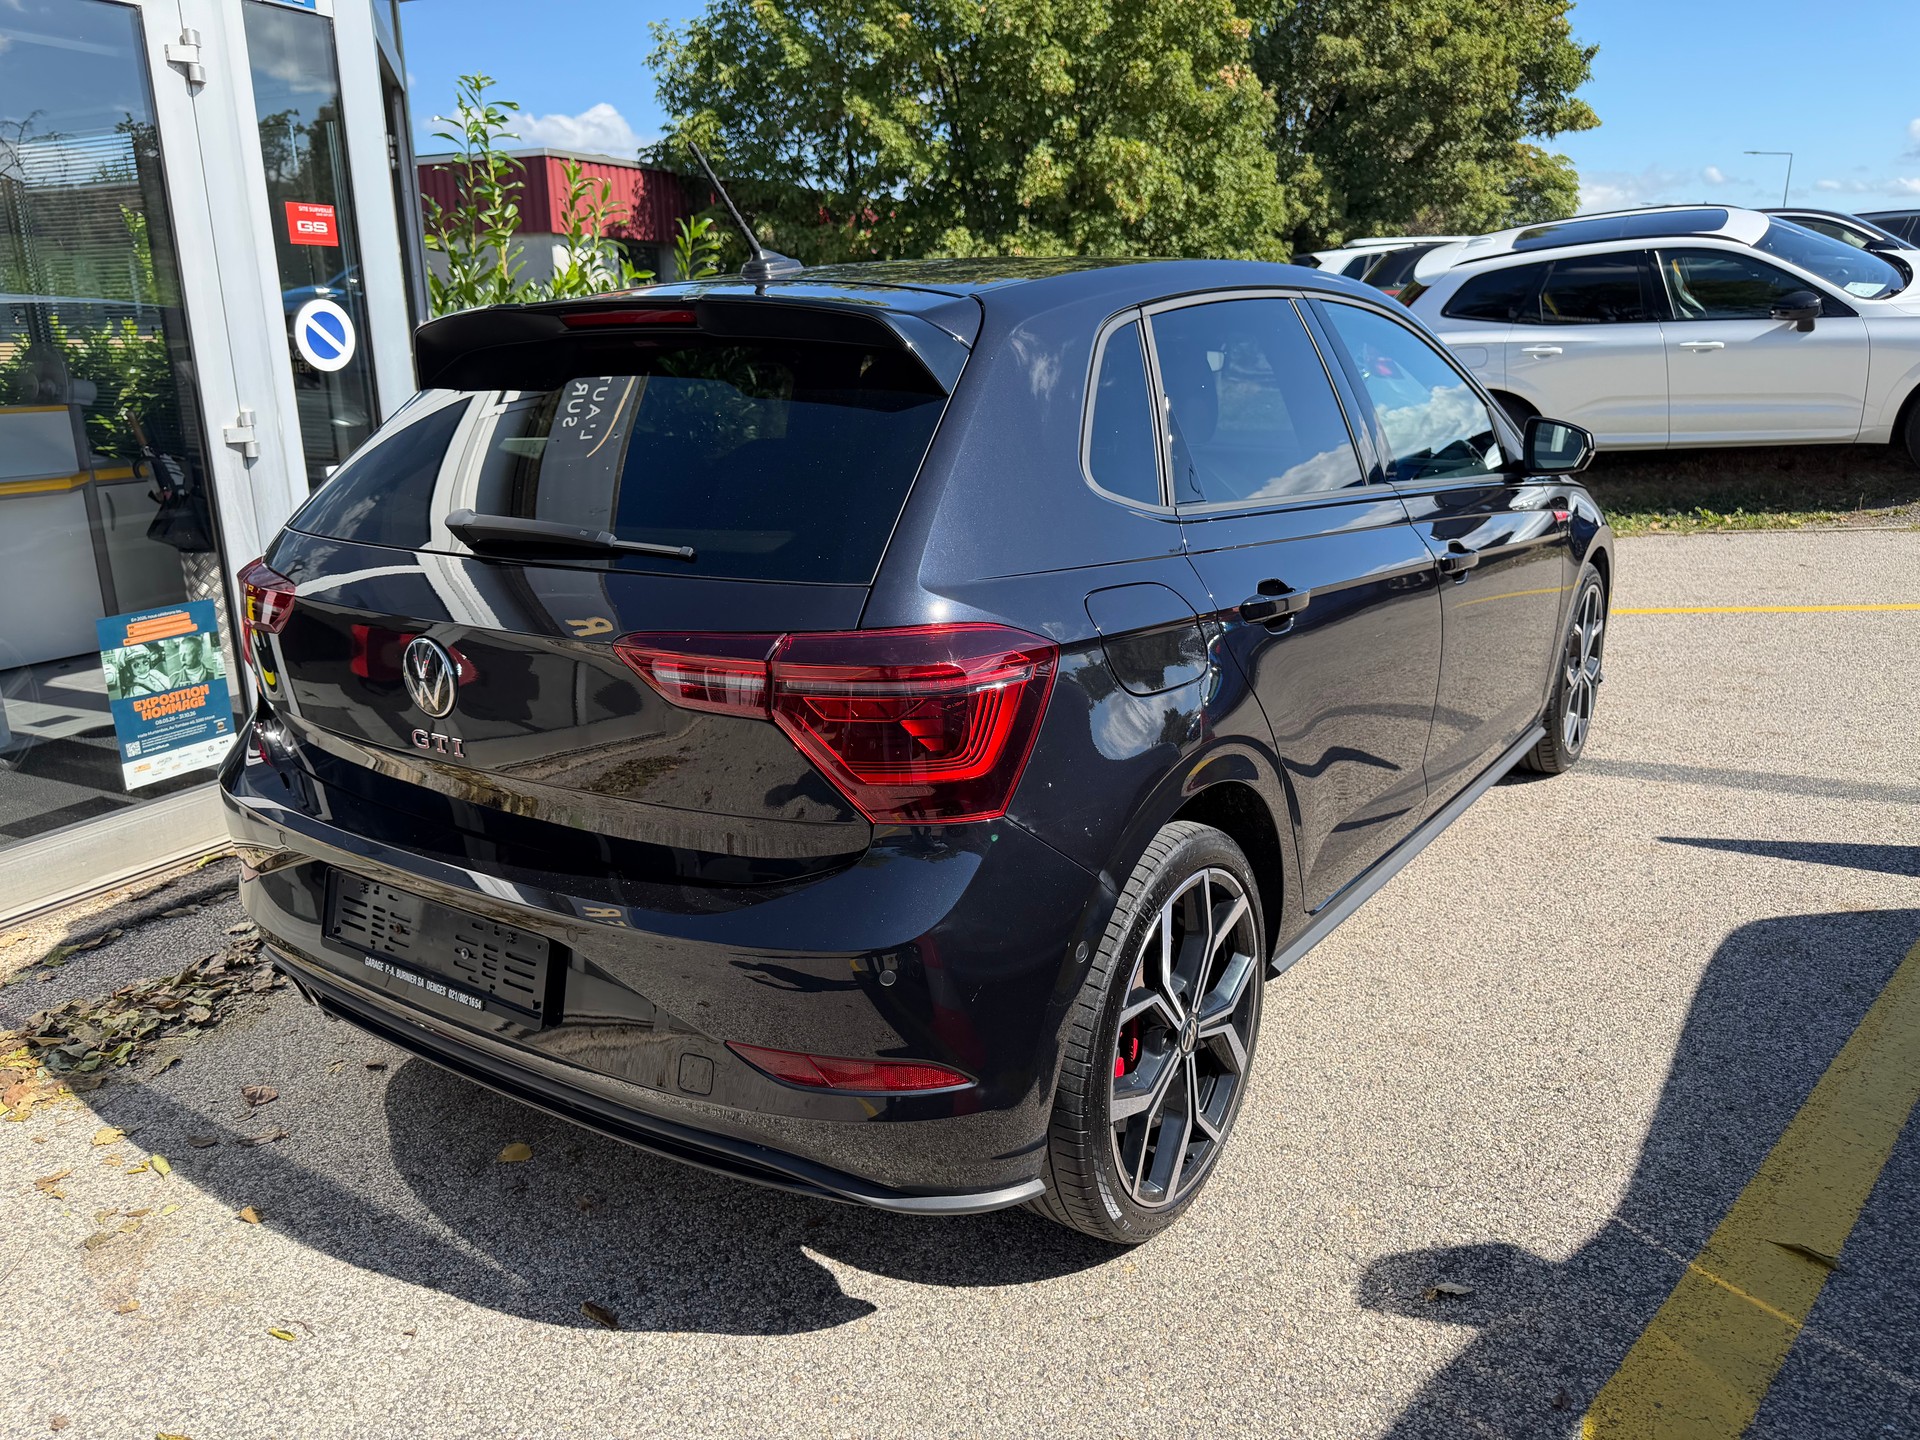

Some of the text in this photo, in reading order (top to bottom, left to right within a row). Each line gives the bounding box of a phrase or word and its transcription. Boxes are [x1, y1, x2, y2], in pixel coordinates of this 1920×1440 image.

[296, 220, 329, 233] GS
[133, 684, 210, 713] EXPOSITION
[142, 696, 207, 721] HOMMAGE
[411, 728, 466, 758] GTI
[364, 956, 384, 972] GARAGE
[396, 968, 417, 985] BURNIER
[417, 977, 425, 988] SA
[426, 980, 447, 996] DENGES
